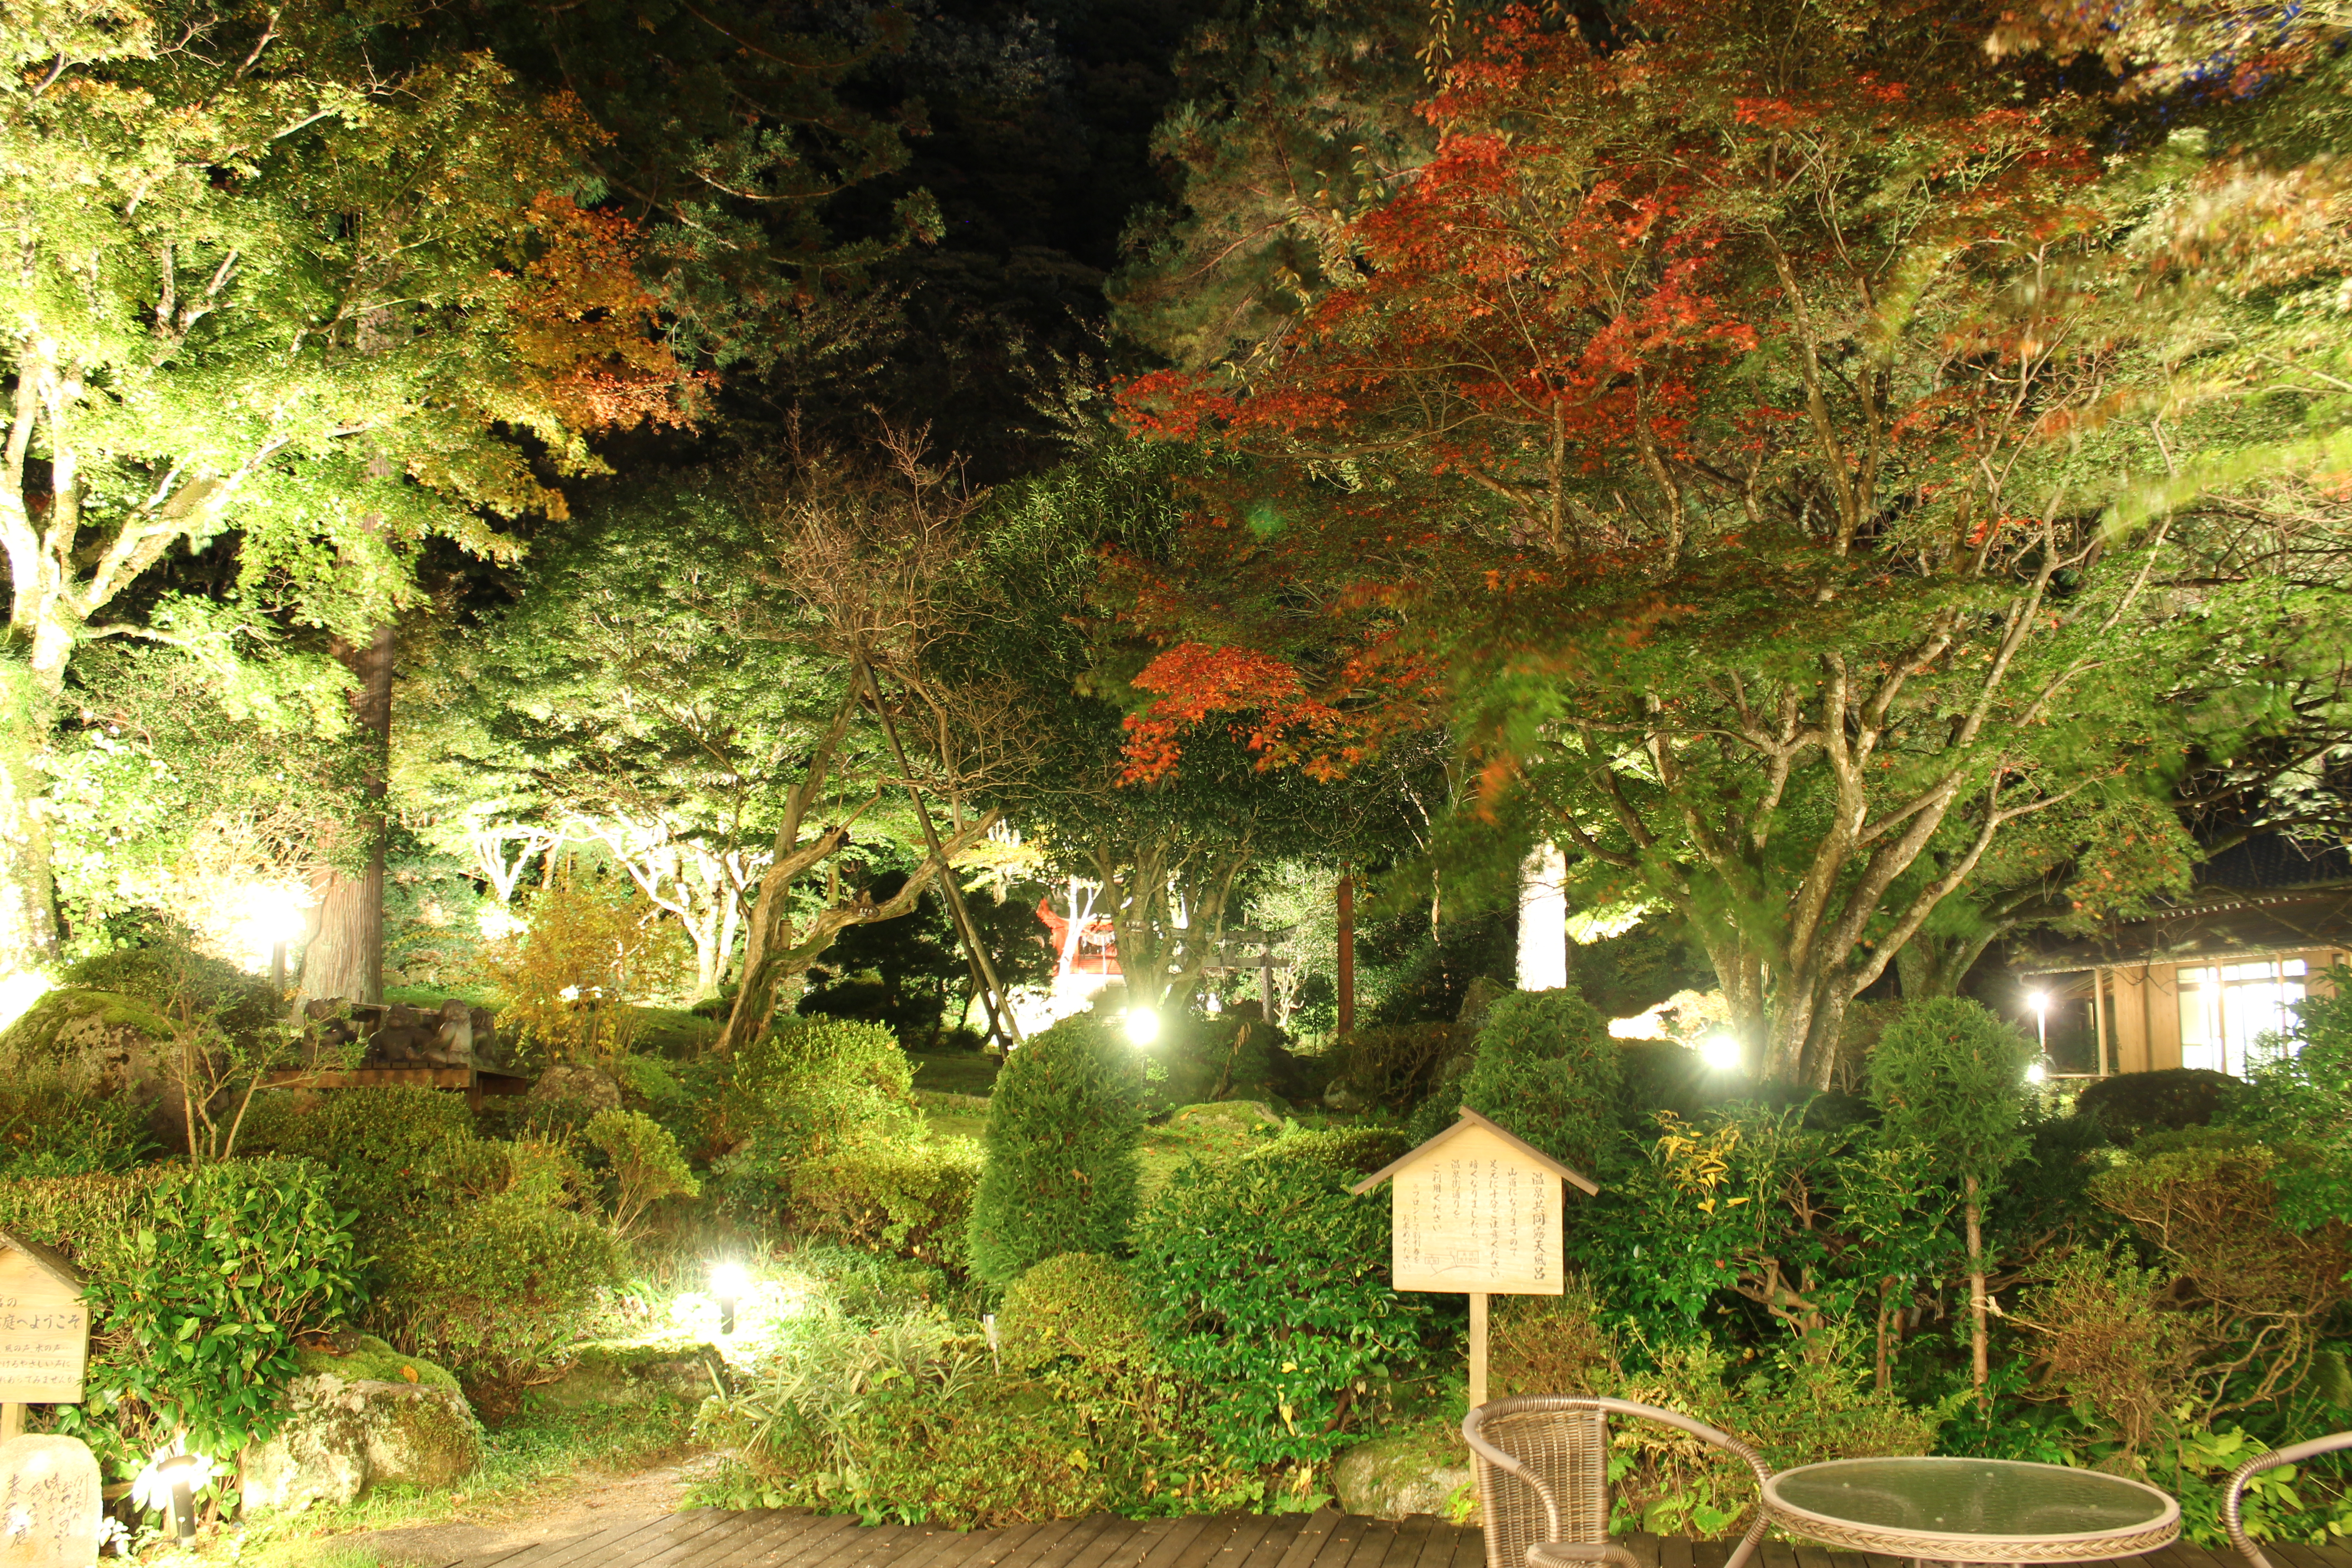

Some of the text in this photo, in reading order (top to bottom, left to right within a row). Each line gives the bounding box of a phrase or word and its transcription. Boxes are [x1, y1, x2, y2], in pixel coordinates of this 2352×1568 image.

[1451, 1159, 1461, 1219] 温泉街通りを
[1469, 1159, 1479, 1239] 暗くなりましたら
[1532, 1172, 1546, 1280] 温泉共同露天風呂
[0, 1314, 81, 1330] 庭へようこそ
